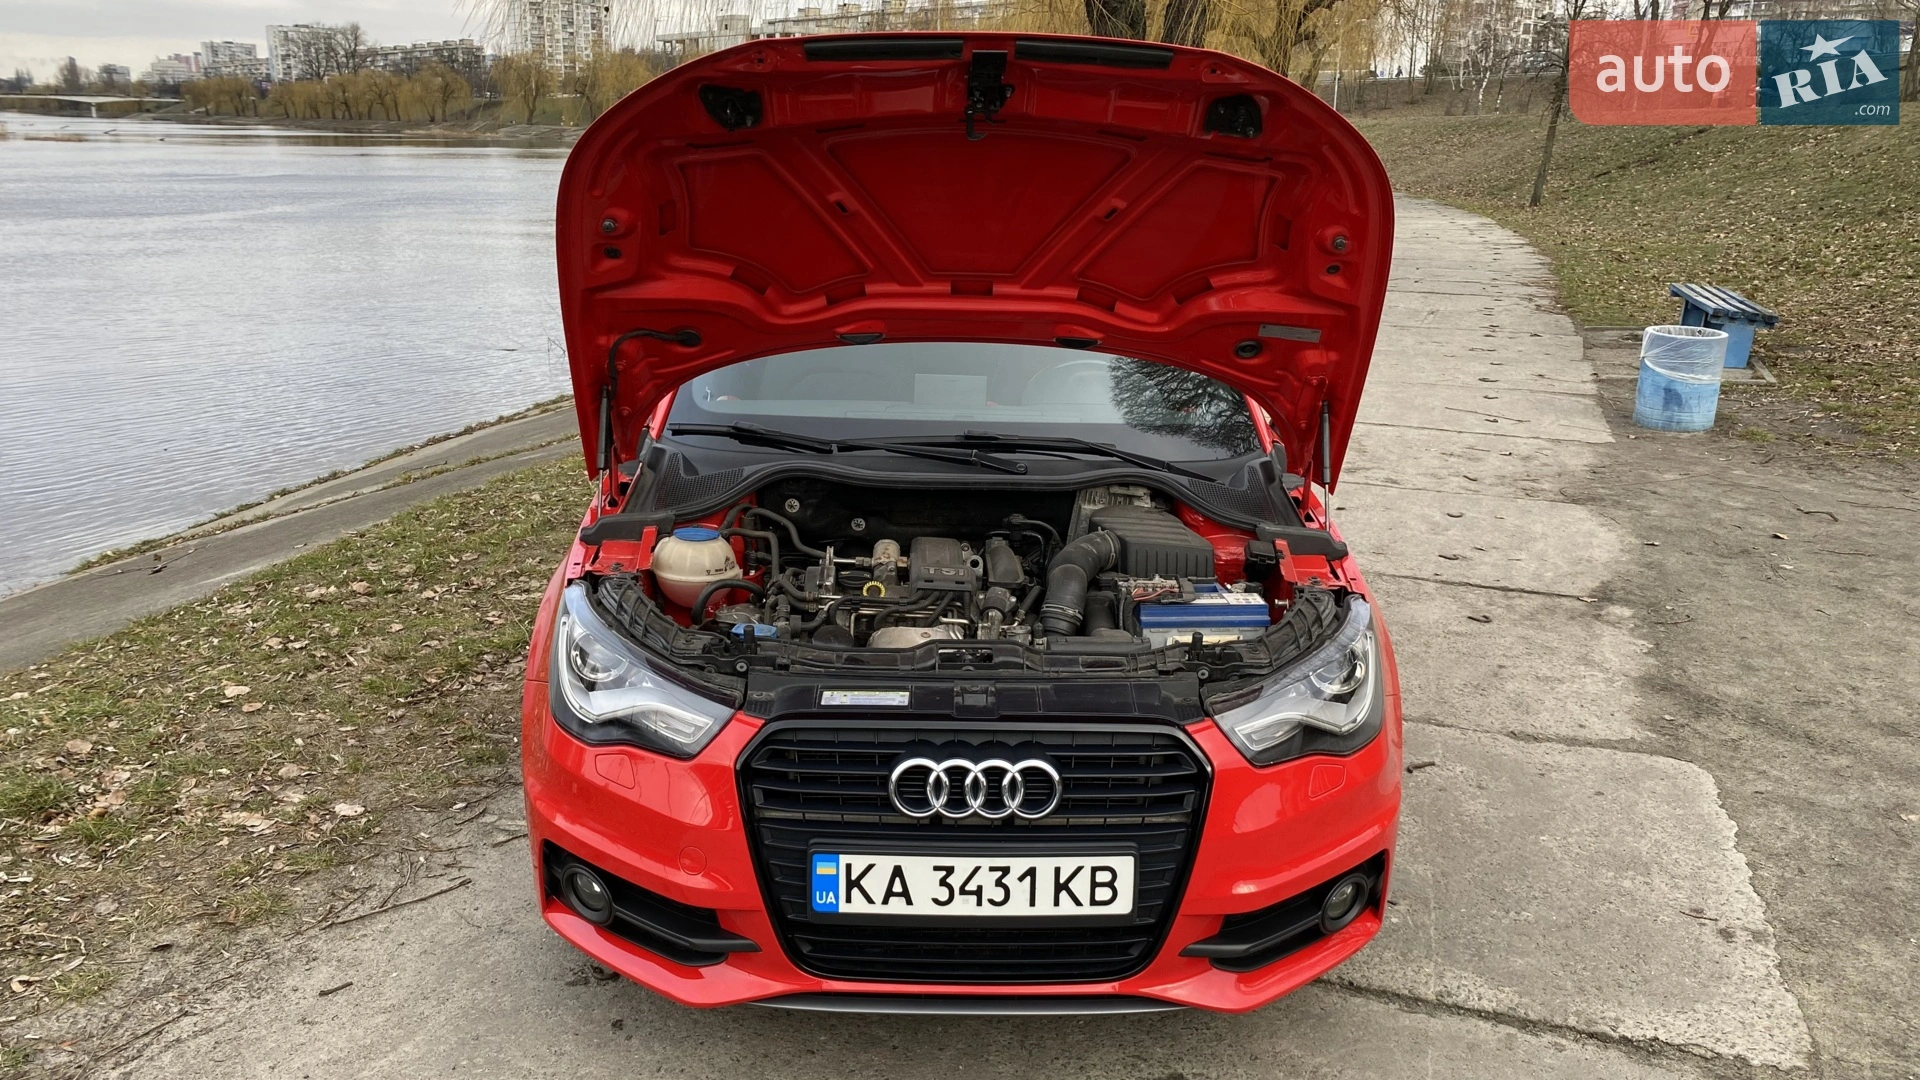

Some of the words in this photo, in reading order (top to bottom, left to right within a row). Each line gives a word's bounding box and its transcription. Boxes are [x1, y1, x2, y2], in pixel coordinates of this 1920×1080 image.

[815, 891, 837, 905] UA
[845, 862, 914, 906] KA
[931, 865, 1037, 908] 3431
[1053, 865, 1119, 908] KB
